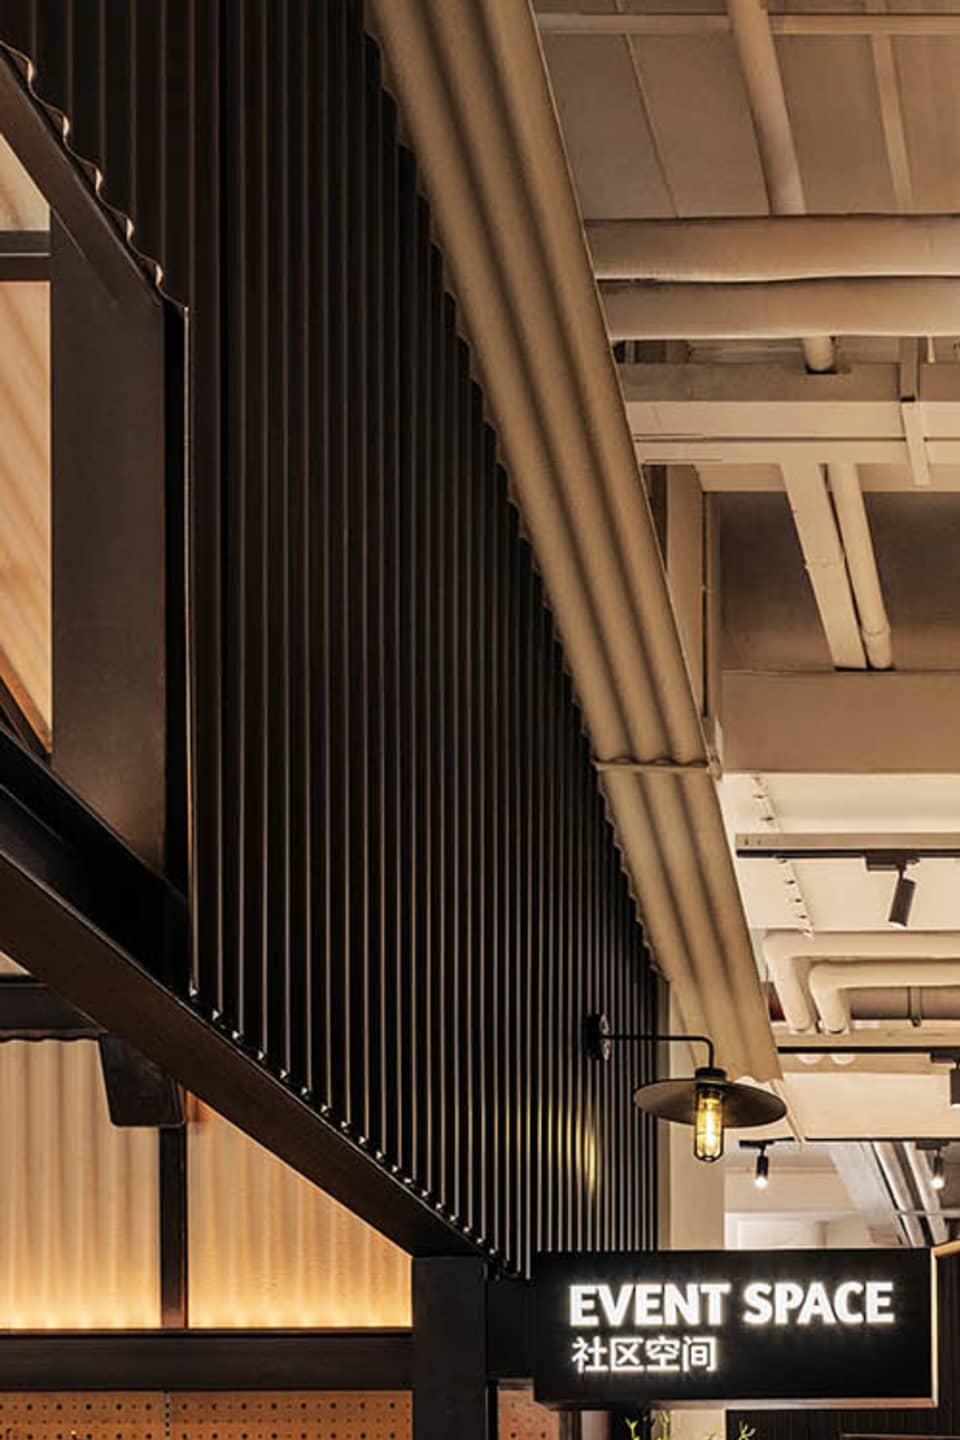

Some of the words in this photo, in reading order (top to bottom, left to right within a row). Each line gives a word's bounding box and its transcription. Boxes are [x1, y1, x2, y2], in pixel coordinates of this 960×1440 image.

[569, 1284, 730, 1326] EVENT
[742, 1282, 895, 1324] SPACE
[571, 1337, 717, 1373] 社区空间
